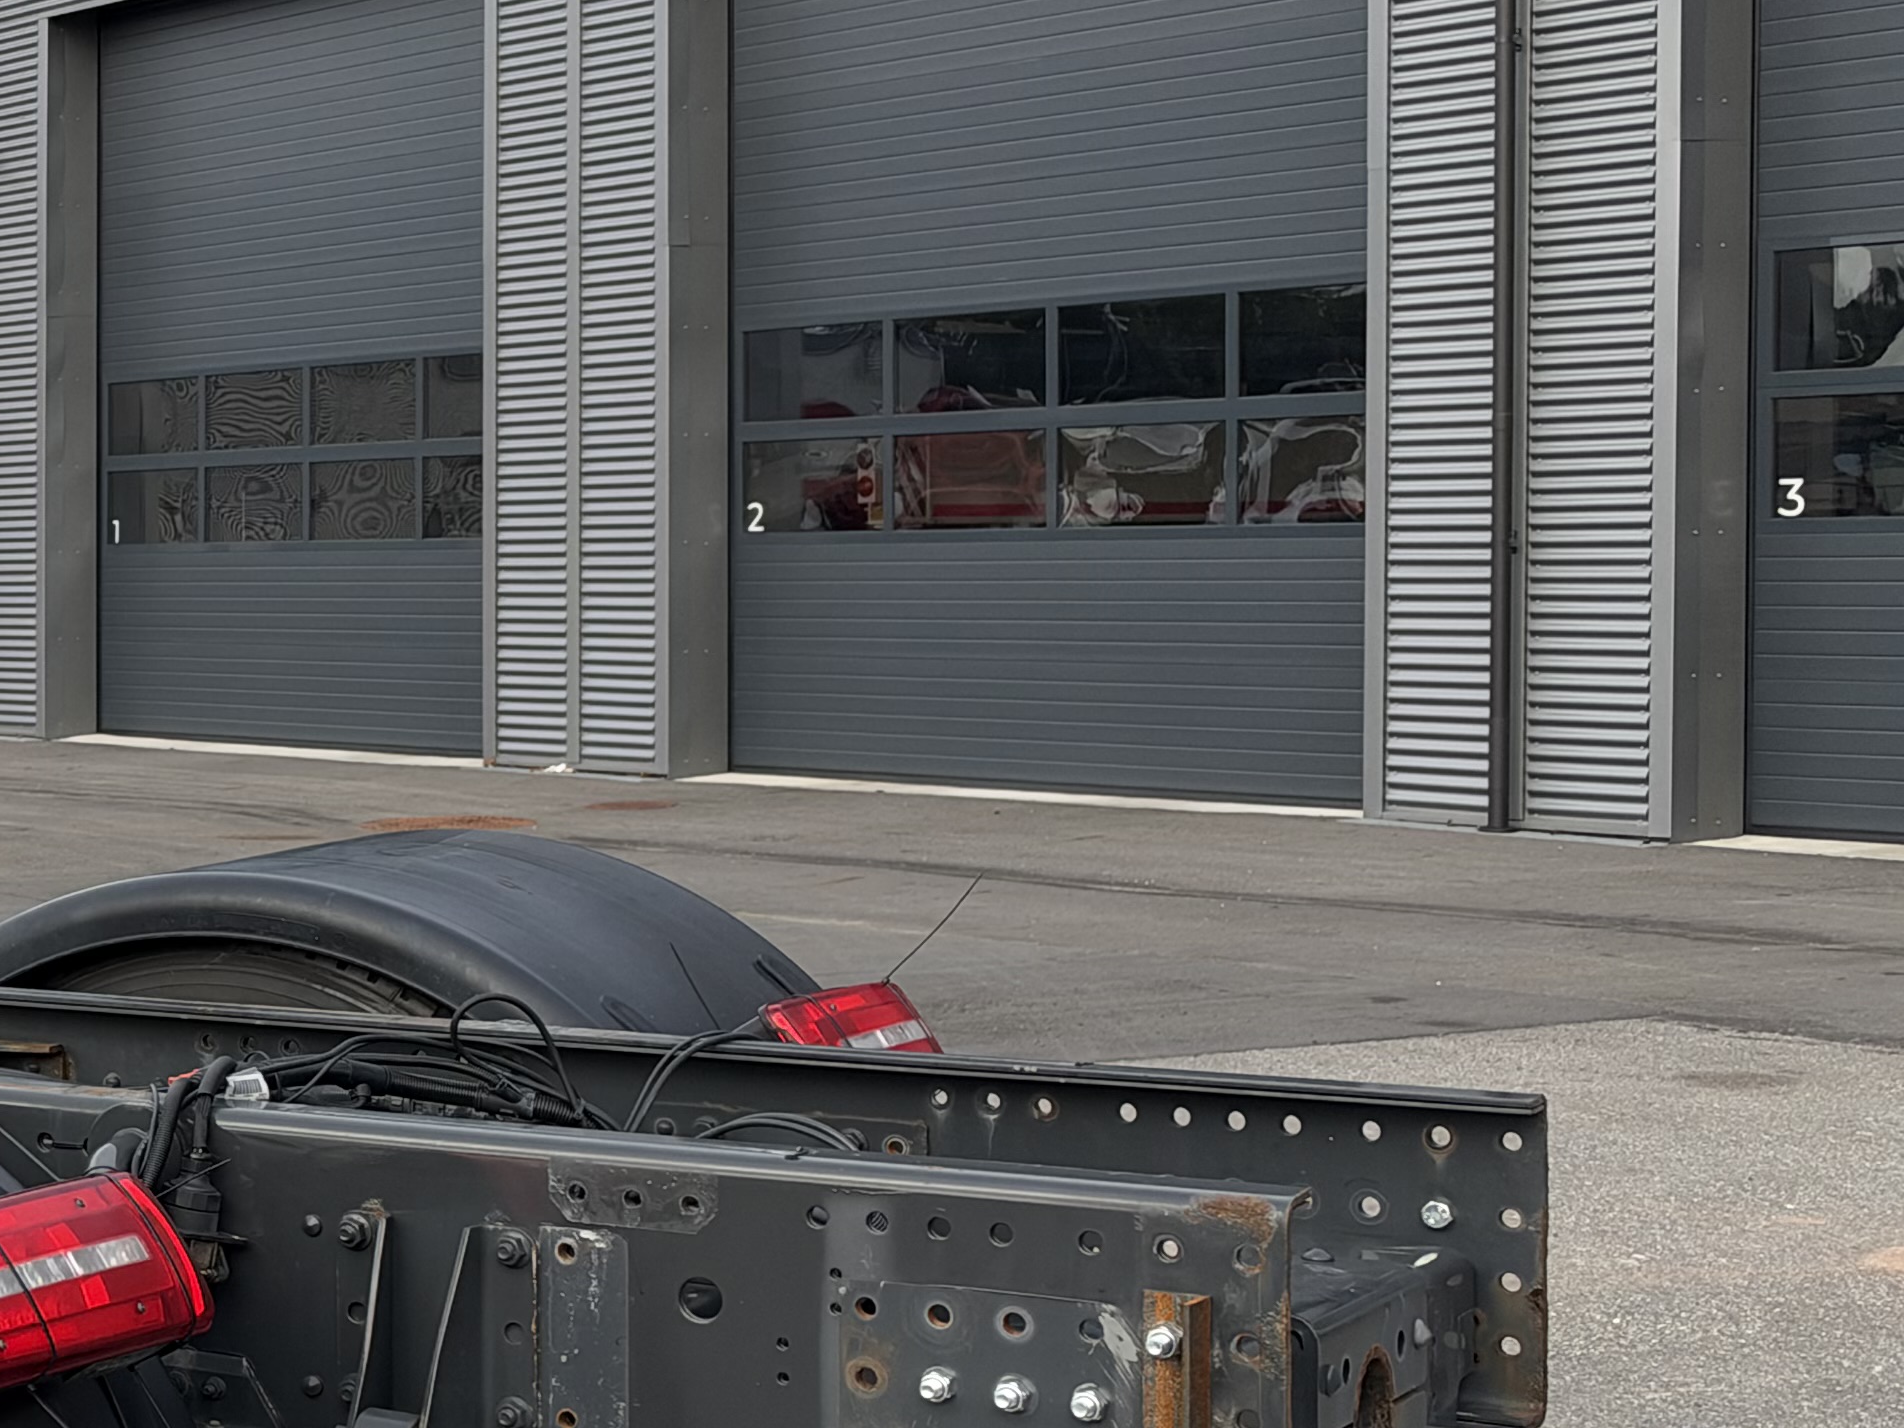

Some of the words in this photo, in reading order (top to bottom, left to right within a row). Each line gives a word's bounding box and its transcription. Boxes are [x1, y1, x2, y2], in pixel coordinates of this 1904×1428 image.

[1777, 477, 1806, 517] 3
[112, 519, 120, 544] 1
[747, 502, 765, 532] 2
